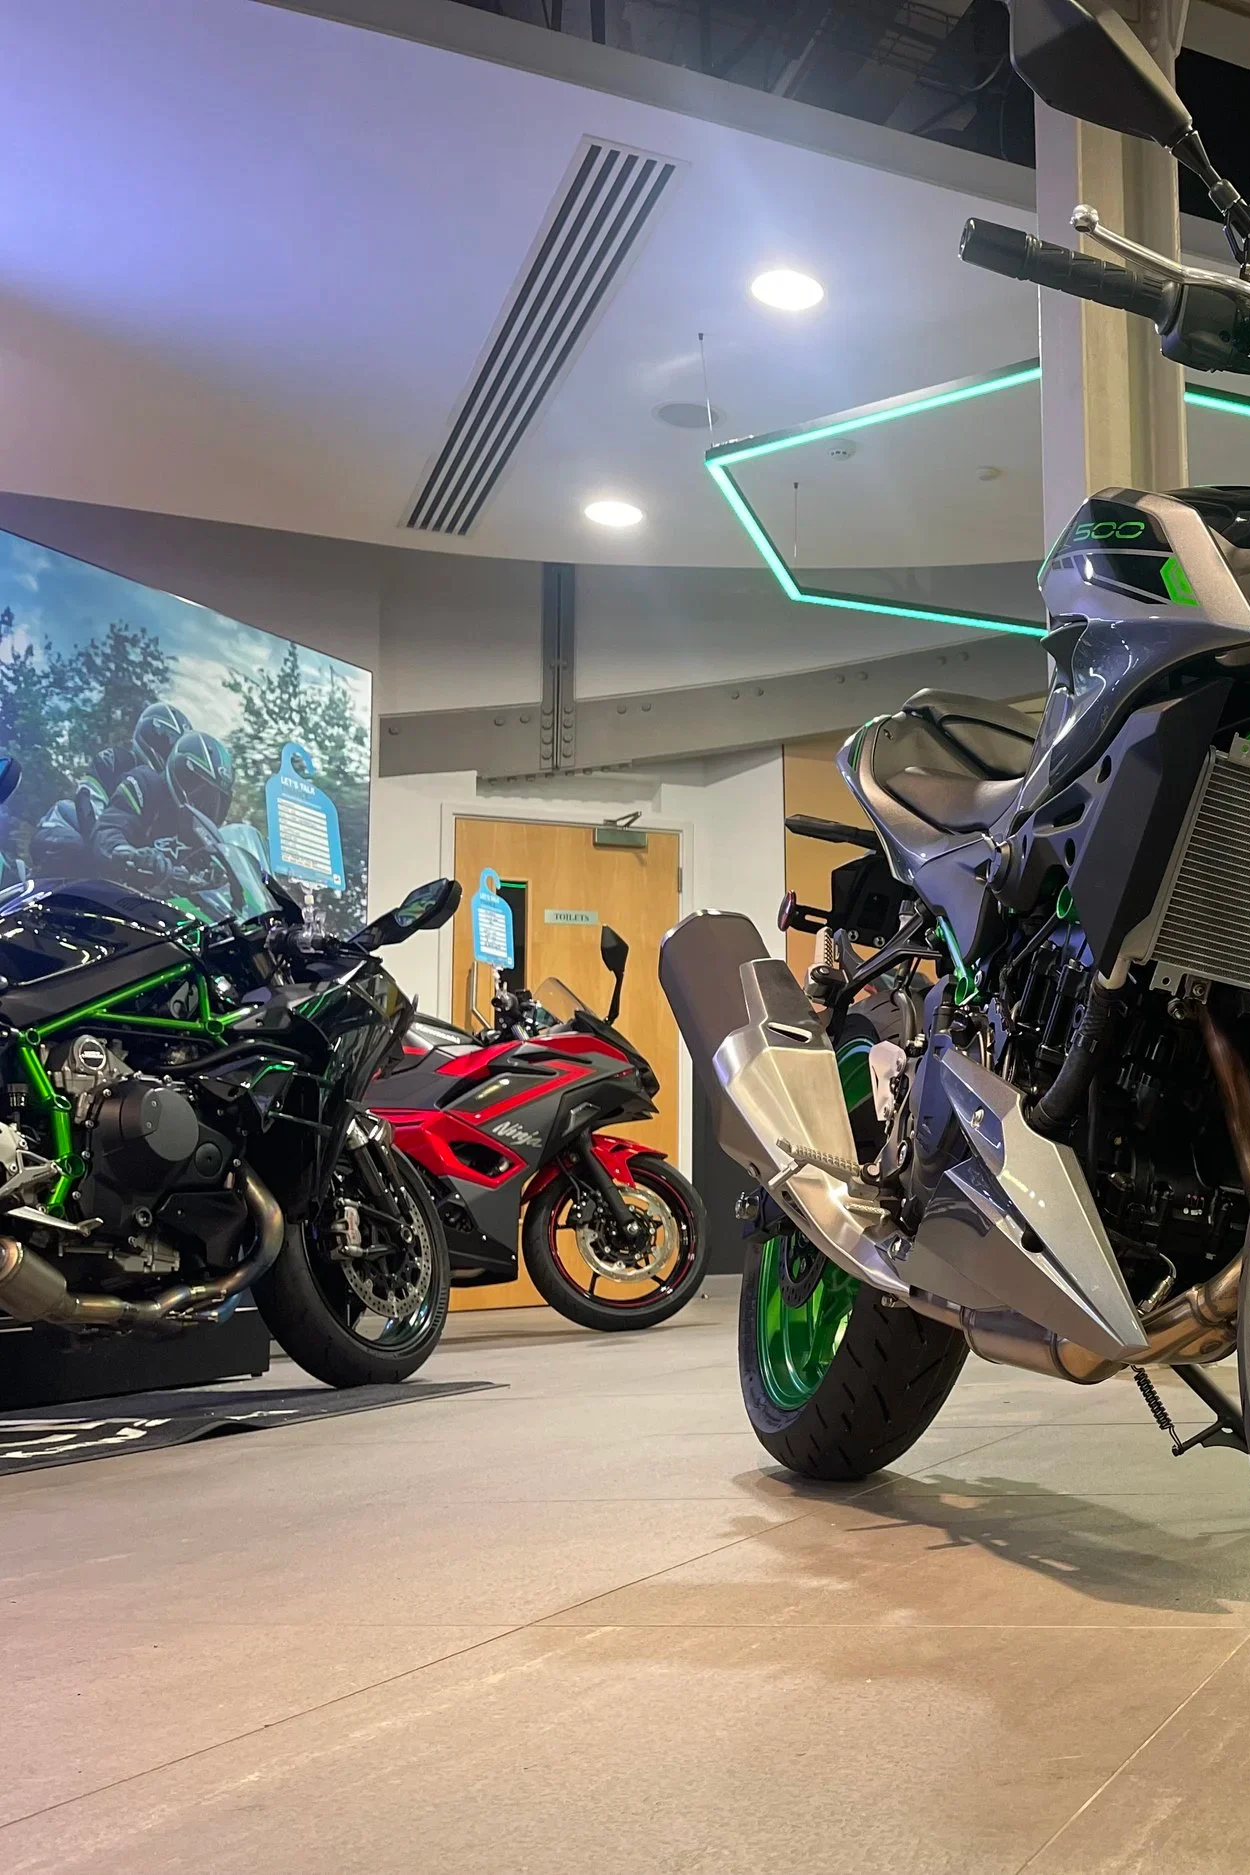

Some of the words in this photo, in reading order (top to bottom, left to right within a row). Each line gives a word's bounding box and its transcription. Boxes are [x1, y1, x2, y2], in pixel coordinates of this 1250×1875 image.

[1072, 521, 1146, 542] 500
[554, 912, 590, 922] TOILETS
[492, 1120, 543, 1148] Ninja
